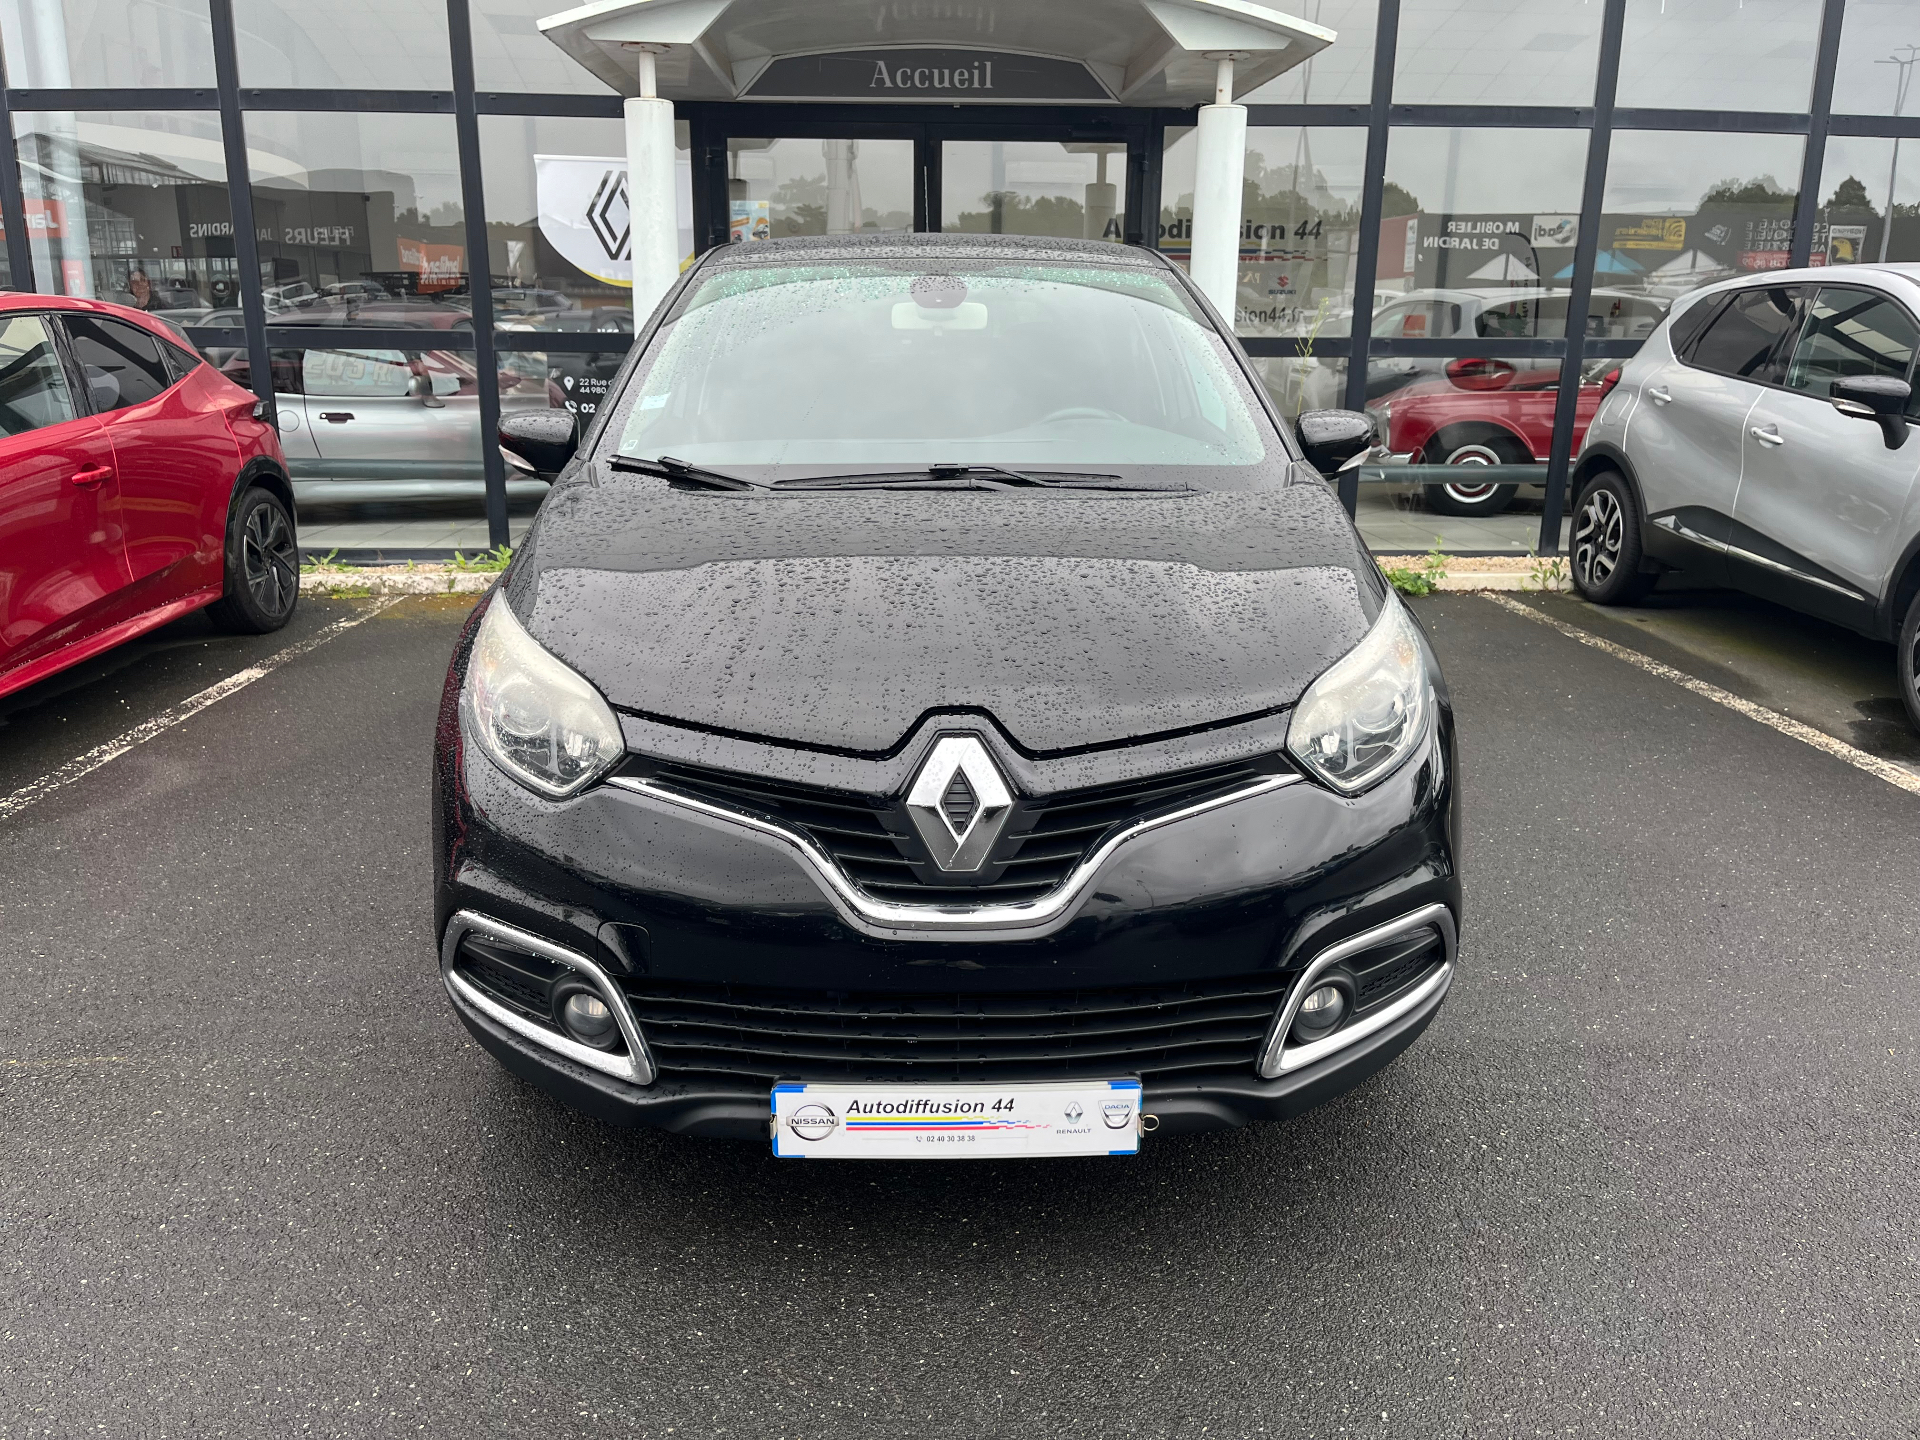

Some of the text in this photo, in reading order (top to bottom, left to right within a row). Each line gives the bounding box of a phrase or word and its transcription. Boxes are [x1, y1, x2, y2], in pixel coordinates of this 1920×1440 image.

[869, 60, 994, 89] Accueil
[1294, 219, 1322, 240] 44
[579, 378, 590, 386] 22
[590, 378, 607, 386] Rue
[579, 386, 607, 394] 44 980
[580, 403, 596, 413] 02
[846, 1098, 1015, 1114] Autodiffusion 44
[926, 1135, 936, 1143] 02
